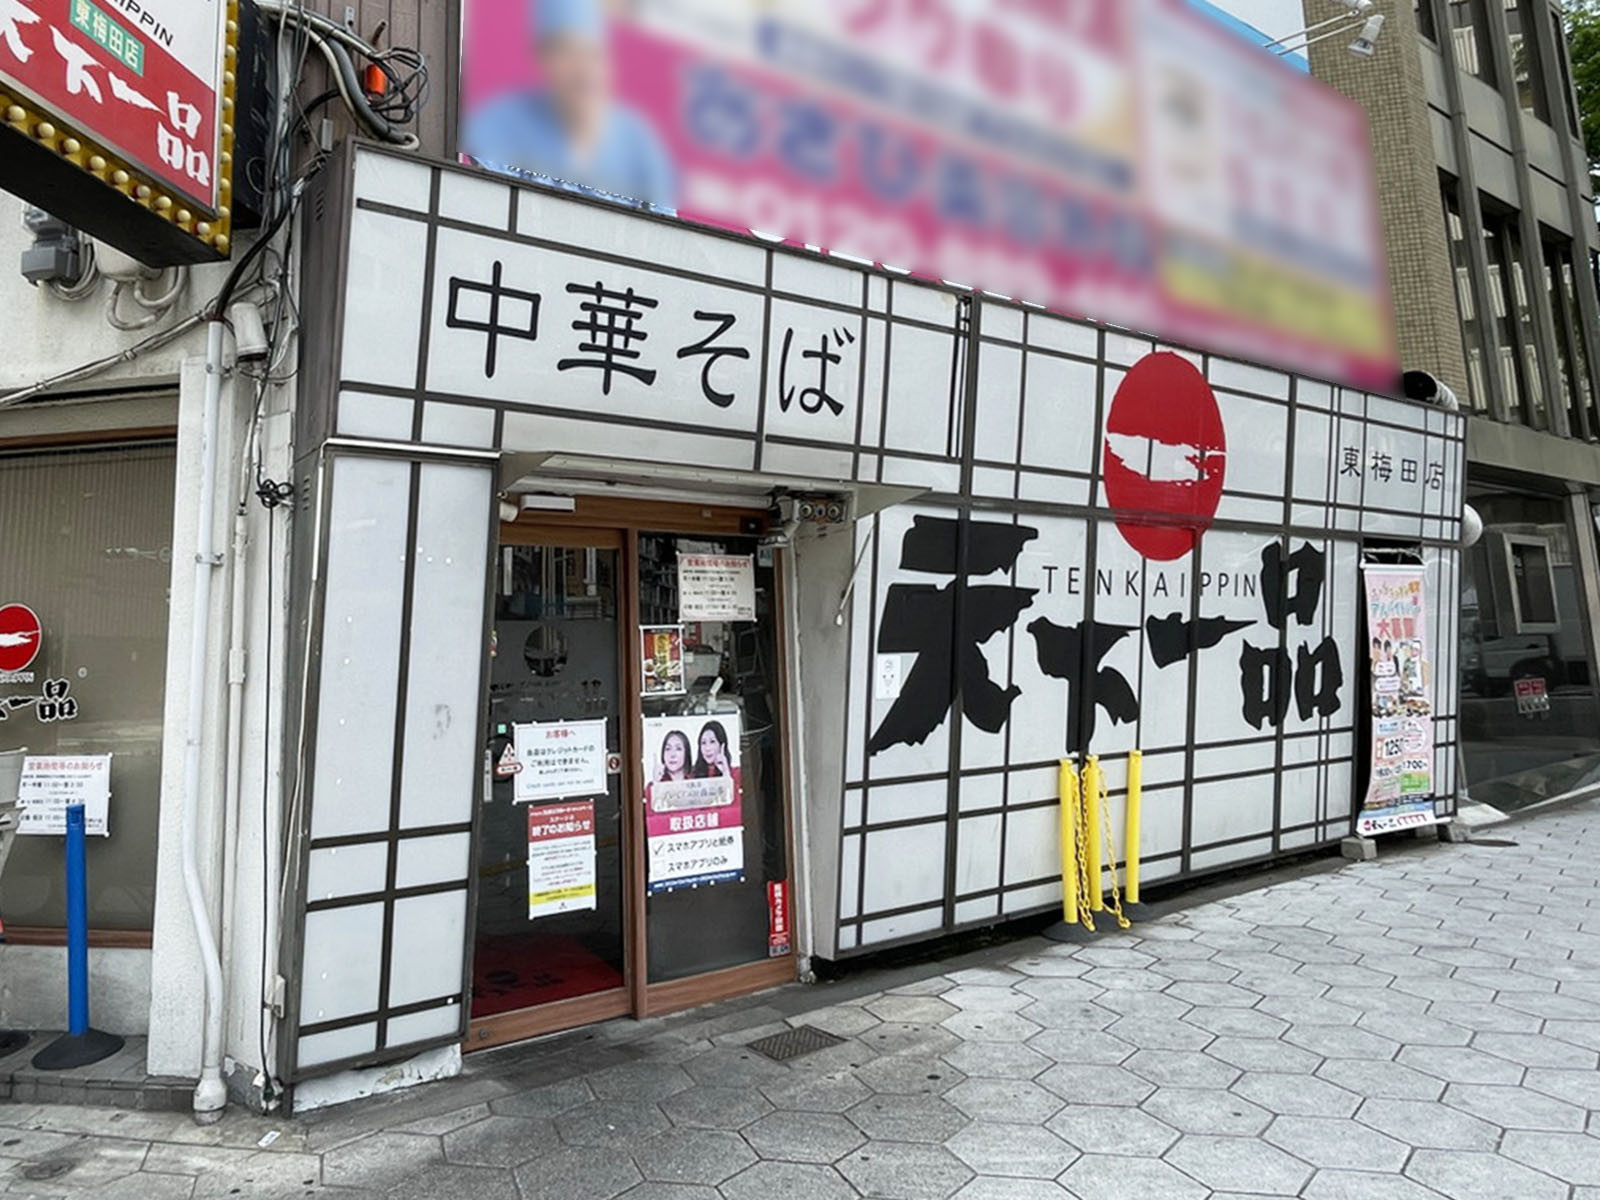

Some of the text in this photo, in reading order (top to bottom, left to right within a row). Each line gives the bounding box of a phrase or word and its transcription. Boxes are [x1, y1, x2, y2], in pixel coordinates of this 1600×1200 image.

[73, 0, 139, 68] 東梅田店
[113, 0, 174, 46] IPPIN
[446, 260, 856, 417] 中華そば
[1340, 446, 1444, 490] 東梅田店
[1042, 565, 1257, 598] TENKAIPPIN
[866, 514, 1343, 757] 天下一品
[0, 679, 78, 721] 一品
[669, 812, 719, 832] 取扱店舗
[667, 856, 728, 873] スマホアプリのみ
